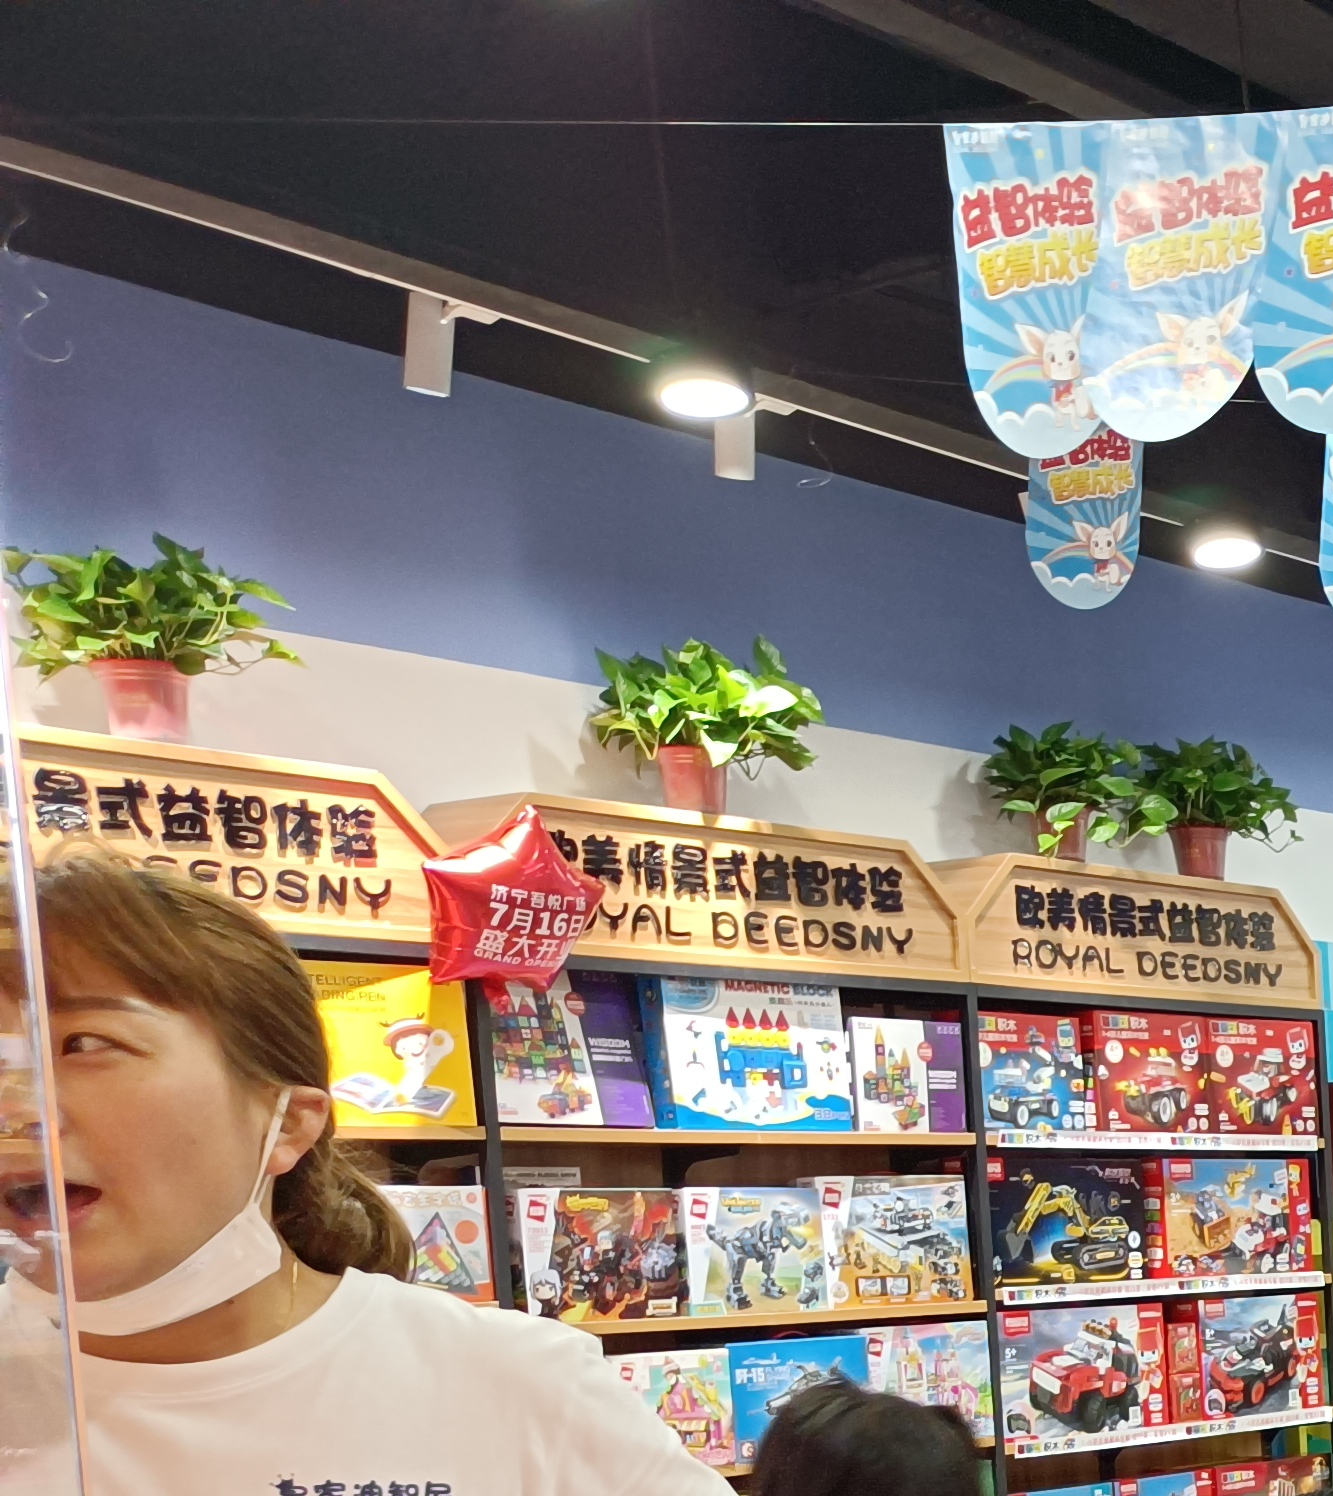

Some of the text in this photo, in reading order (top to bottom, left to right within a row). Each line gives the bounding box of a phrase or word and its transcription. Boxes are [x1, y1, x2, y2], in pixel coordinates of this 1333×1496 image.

[962, 177, 1093, 247] 益智体验
[979, 232, 1097, 295] 智慧成长
[489, 903, 585, 938] 7月16日
[491, 884, 586, 911] 济宁吾悦广场
[1014, 884, 1275, 952] 欧美情景式益智体验
[588, 902, 914, 955] YAL DEEDSNY
[311, 973, 382, 986] TELLIGENT
[473, 948, 521, 965] GRAND
[1012, 938, 1283, 988] ROYAL DEEDSNY
